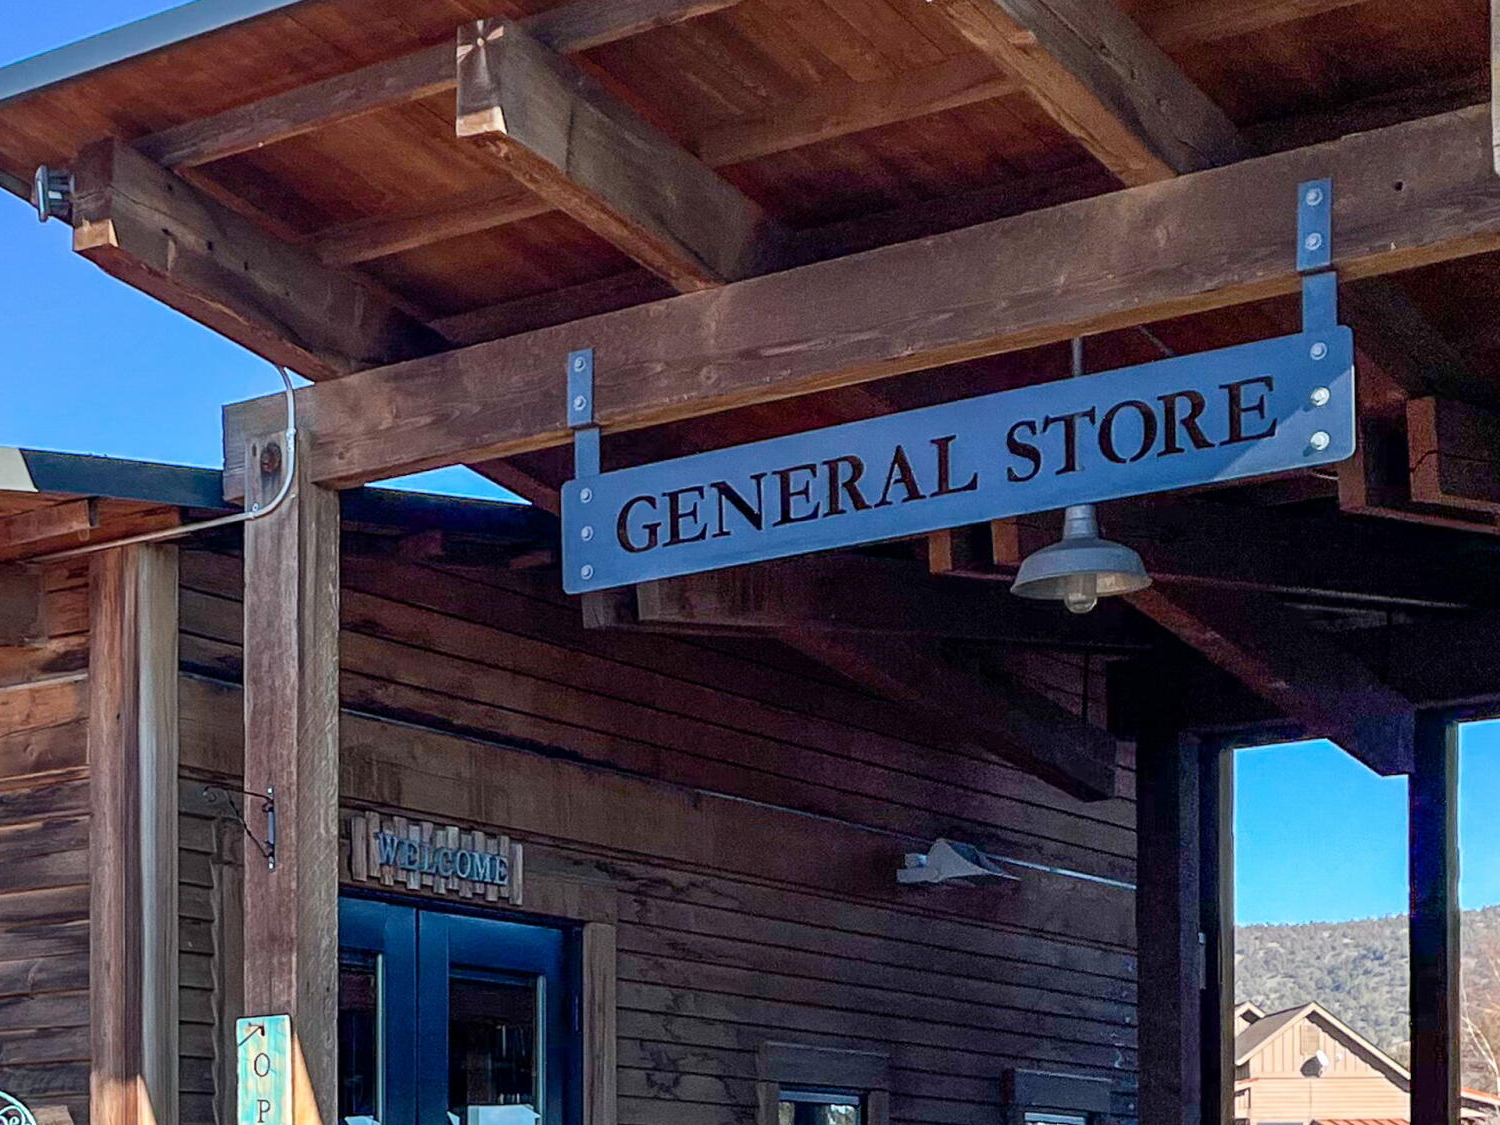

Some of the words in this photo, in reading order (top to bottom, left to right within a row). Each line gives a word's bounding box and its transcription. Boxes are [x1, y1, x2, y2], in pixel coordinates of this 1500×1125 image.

[616, 435, 979, 554] GENERAL
[1005, 375, 1278, 483] STORE
[374, 831, 510, 886] WELCOME
